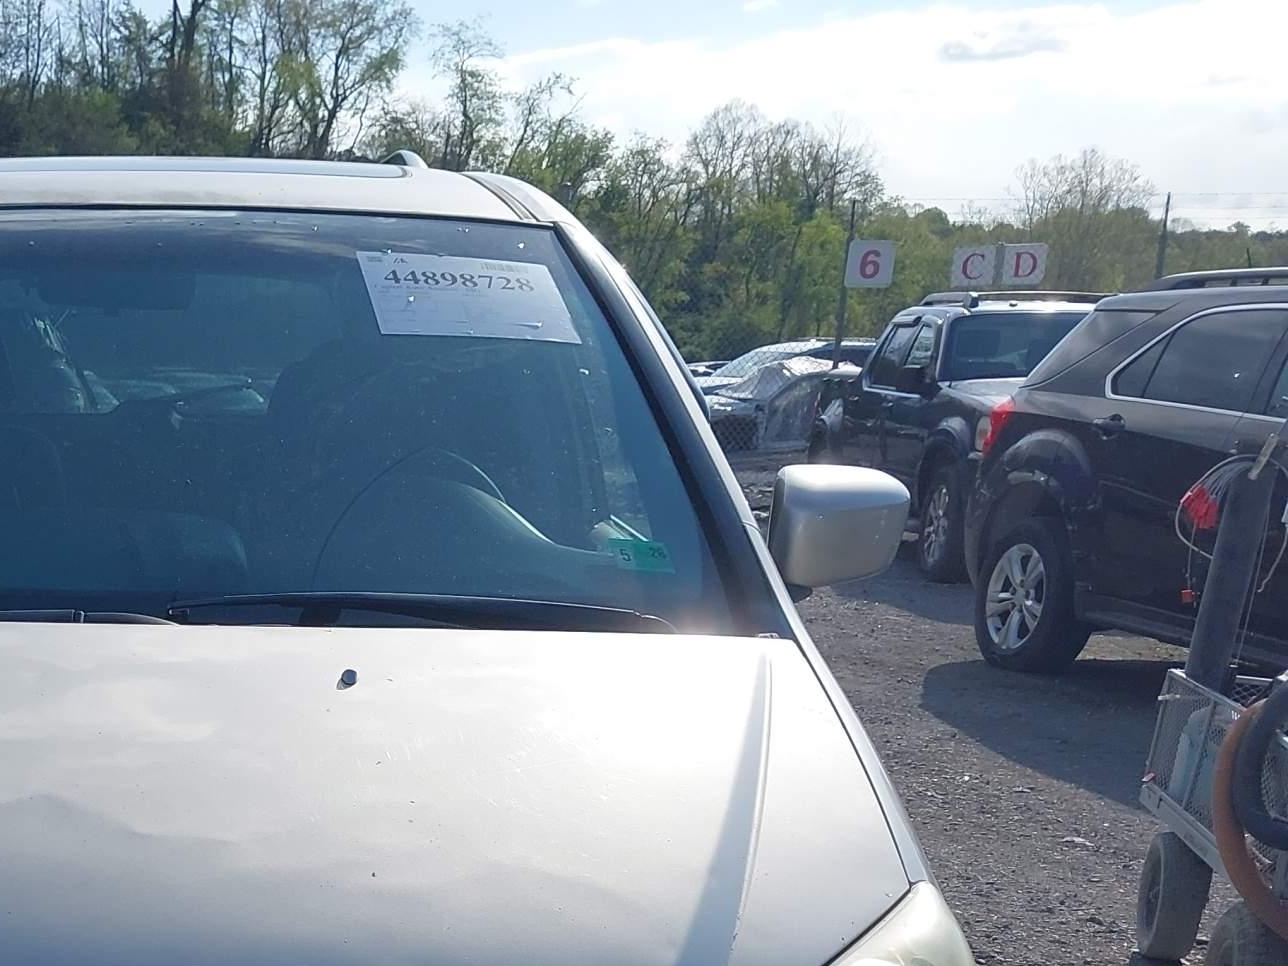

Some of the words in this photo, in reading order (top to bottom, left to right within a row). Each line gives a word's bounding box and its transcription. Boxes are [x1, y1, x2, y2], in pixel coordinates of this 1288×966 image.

[859, 249, 882, 279] 6
[961, 253, 985, 280] C
[1013, 251, 1038, 277] D
[383, 269, 535, 292] 44898728
[620, 549, 632, 562] 5
